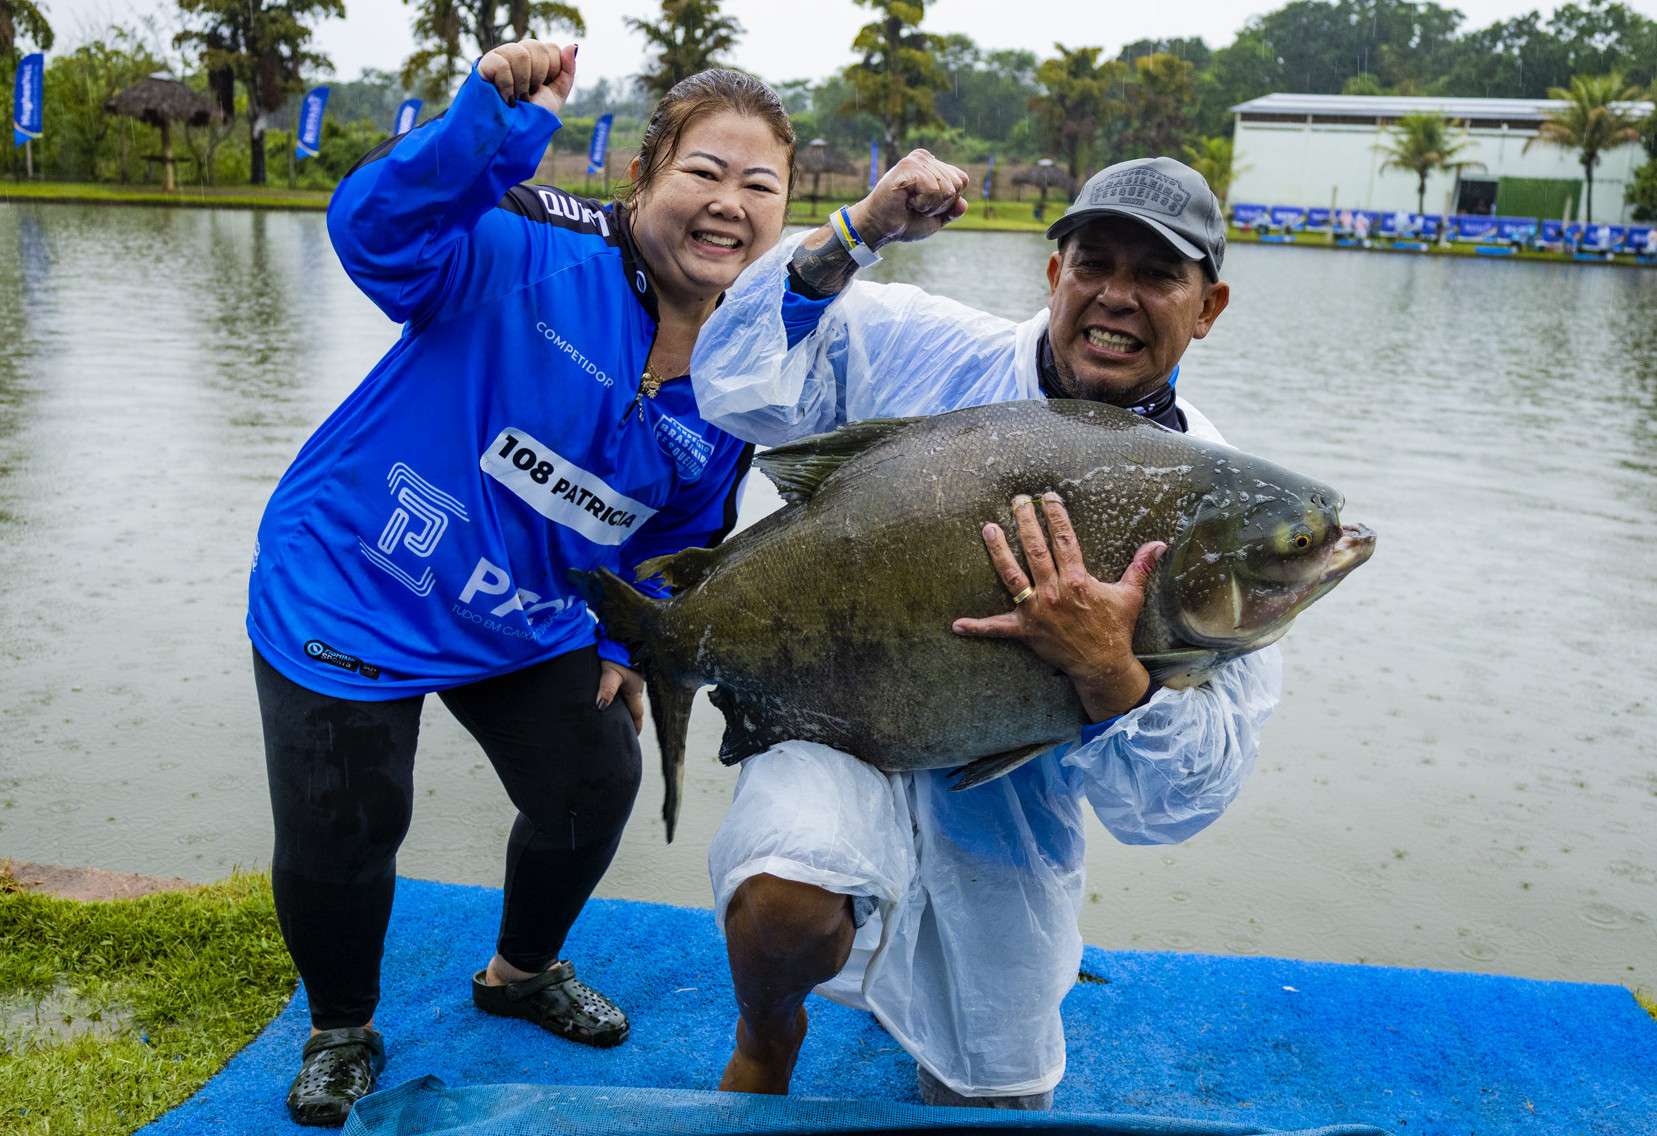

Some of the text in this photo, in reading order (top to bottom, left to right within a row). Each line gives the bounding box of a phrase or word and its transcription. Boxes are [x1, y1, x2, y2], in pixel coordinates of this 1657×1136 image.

[1093, 186, 1179, 213] PESQUEIROS
[1095, 176, 1184, 203] BRASILEIRO
[535, 321, 614, 389] COMPETIDOR
[498, 434, 637, 529] 108 PATRICIA
[451, 604, 483, 624] TUDO
[483, 619, 502, 633] EM
